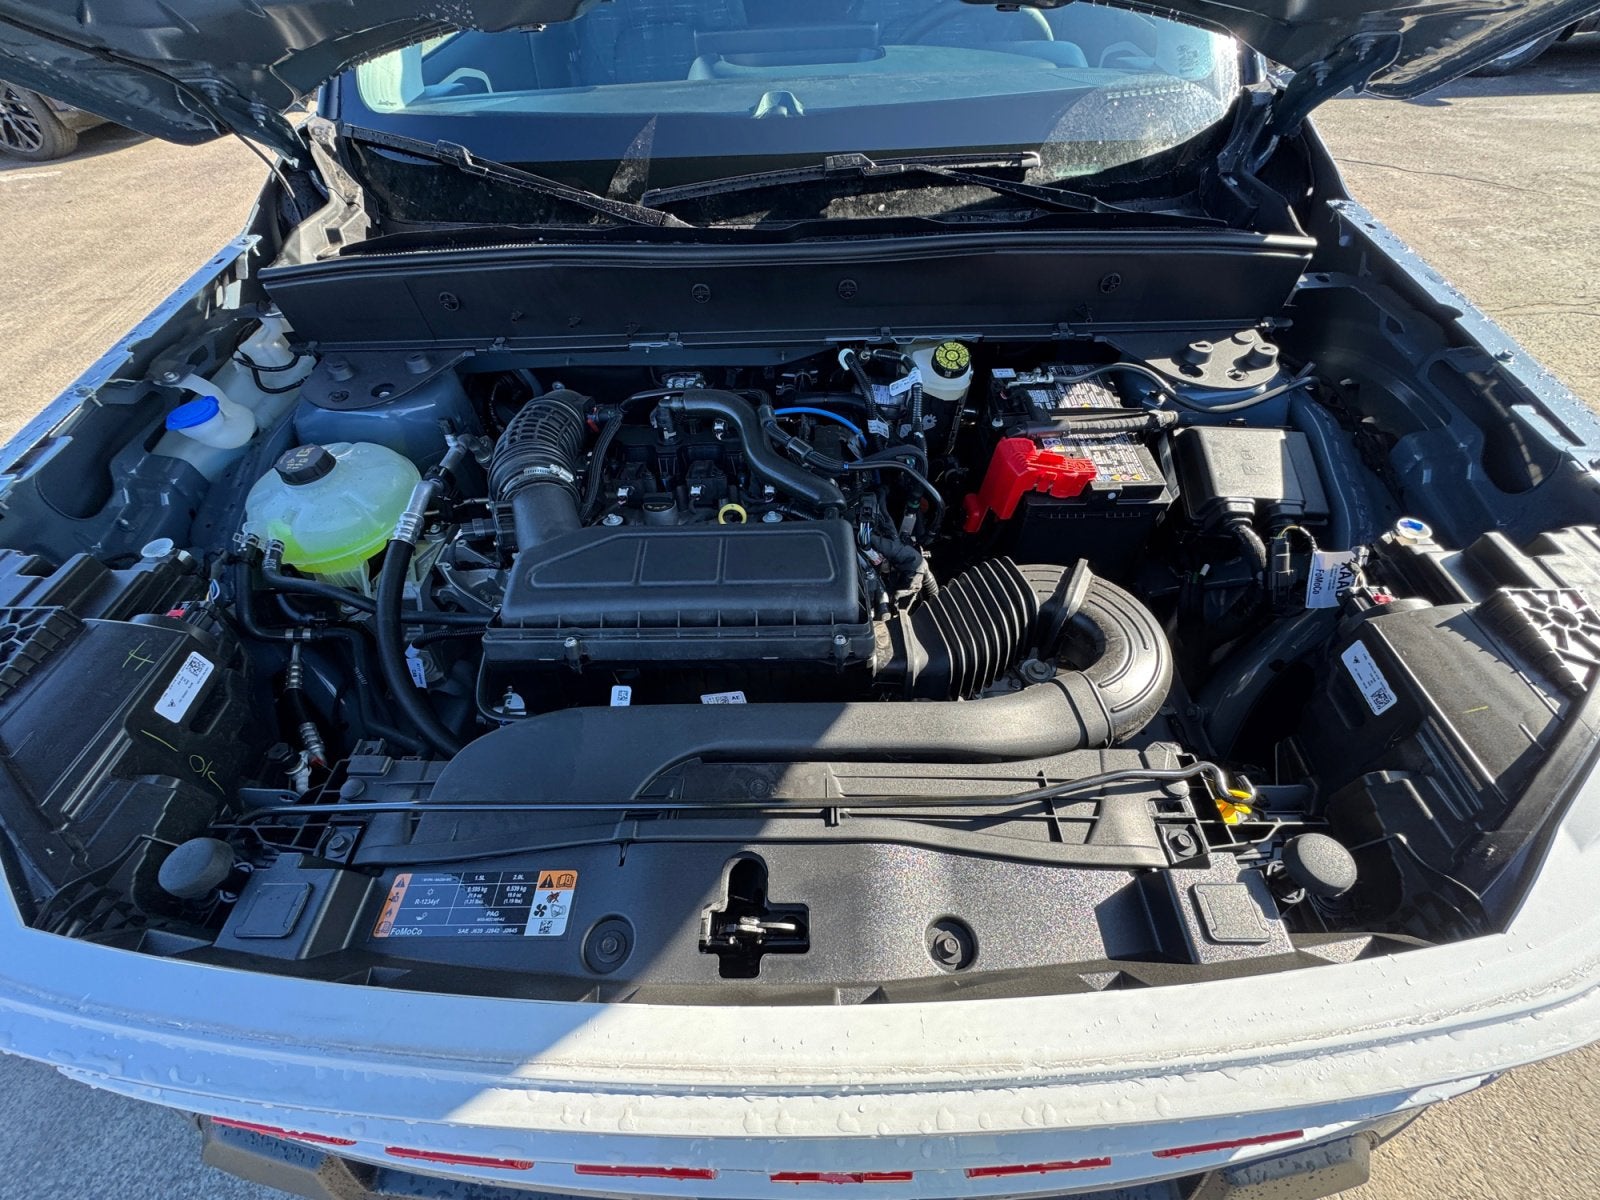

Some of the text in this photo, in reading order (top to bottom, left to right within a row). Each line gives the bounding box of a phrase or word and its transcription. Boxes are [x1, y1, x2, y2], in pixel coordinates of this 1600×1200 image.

[1312, 568, 1324, 595] FoMoCo
[414, 898, 440, 906] R-1234yf
[390, 927, 423, 936] FoMoCo
